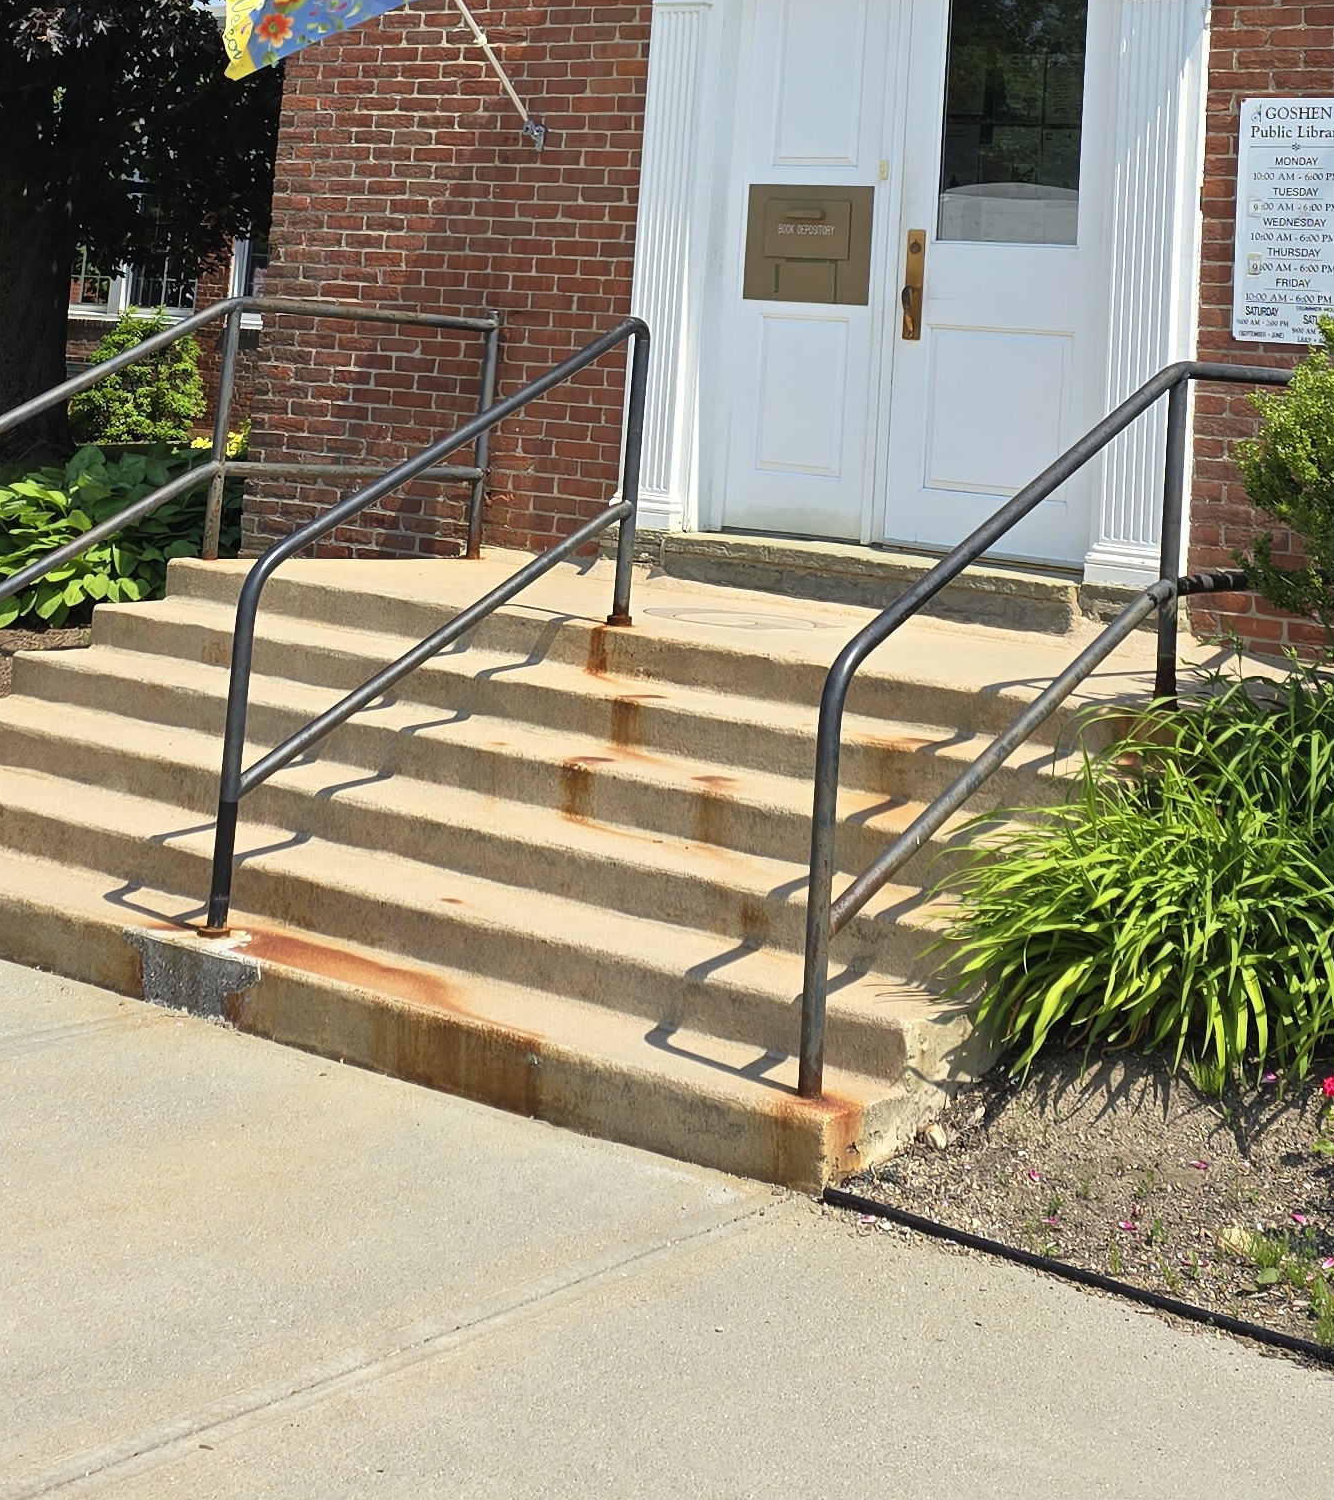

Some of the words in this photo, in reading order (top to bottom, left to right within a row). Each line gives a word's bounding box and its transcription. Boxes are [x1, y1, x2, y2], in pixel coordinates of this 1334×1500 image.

[1265, 106, 1333, 119] GOSHEN
[1250, 125, 1292, 138] Public
[1274, 156, 1319, 166] MONDAY
[1253, 172, 1275, 181] 10:00
[1277, 172, 1295, 181] AM
[1304, 172, 1324, 181] 6:00
[1272, 187, 1319, 197] TUESDAY
[1277, 202, 1295, 212] AM
[1302, 203, 1323, 212] 6:00
[1262, 217, 1327, 227] WEDNESDAY
[778, 223, 795, 234] BOOK
[797, 224, 835, 235] DEPOSITORY
[1250, 232, 1274, 241] 10:00
[1276, 233, 1293, 242] AM
[1299, 233, 1320, 242] 6:00
[1267, 247, 1321, 257] THURSDAY
[1275, 263, 1292, 272] AM
[1299, 264, 1319, 273] 6:00
[1275, 278, 1311, 288] FRIDAY
[1245, 292, 1267, 301] 10:00
[1270, 294, 1287, 302] AM
[1295, 295, 1315, 303] 6:00
[1317, 295, 1332, 304] PM
[1244, 306, 1279, 317] SATURDAY
[1279, 320, 1289, 328] PM
[1306, 327, 1316, 335] AM
